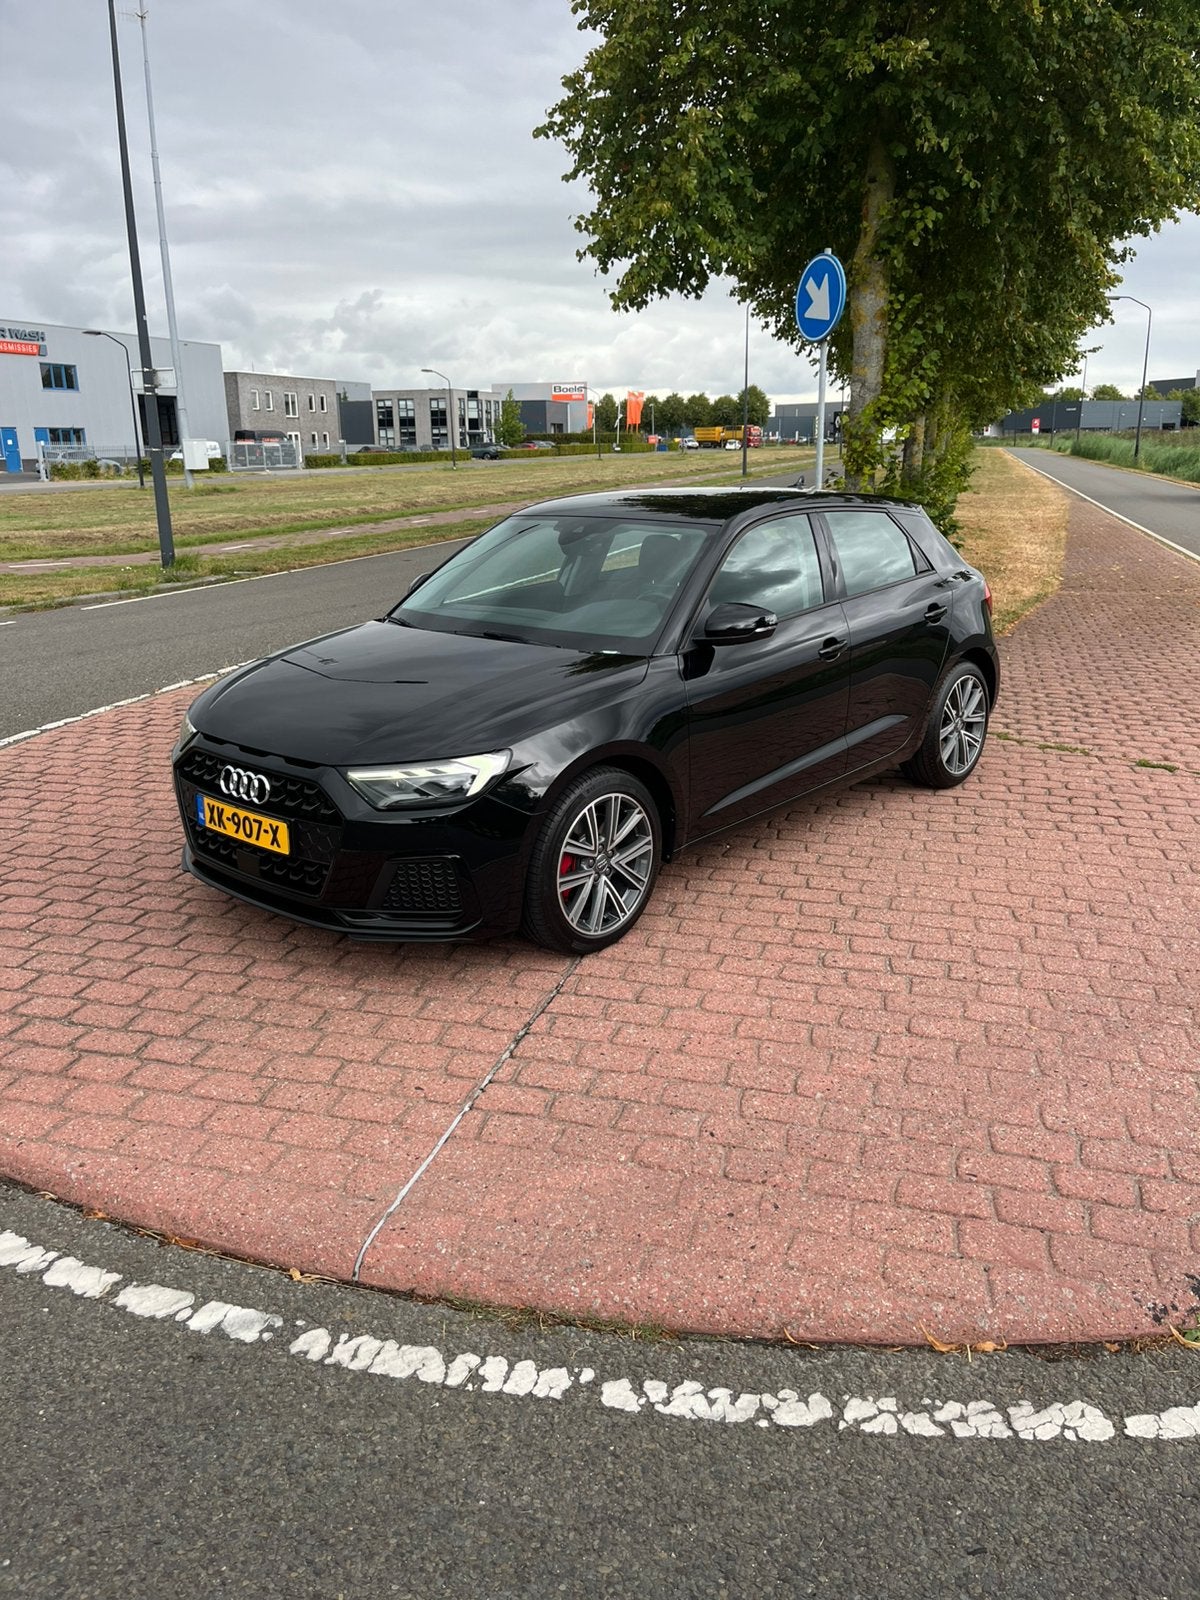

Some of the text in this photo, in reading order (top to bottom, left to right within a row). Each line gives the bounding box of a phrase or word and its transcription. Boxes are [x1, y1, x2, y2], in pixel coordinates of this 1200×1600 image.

[8, 328, 45, 342] WASH
[553, 385, 583, 393] Boels
[207, 803, 281, 848] XK-907-X
